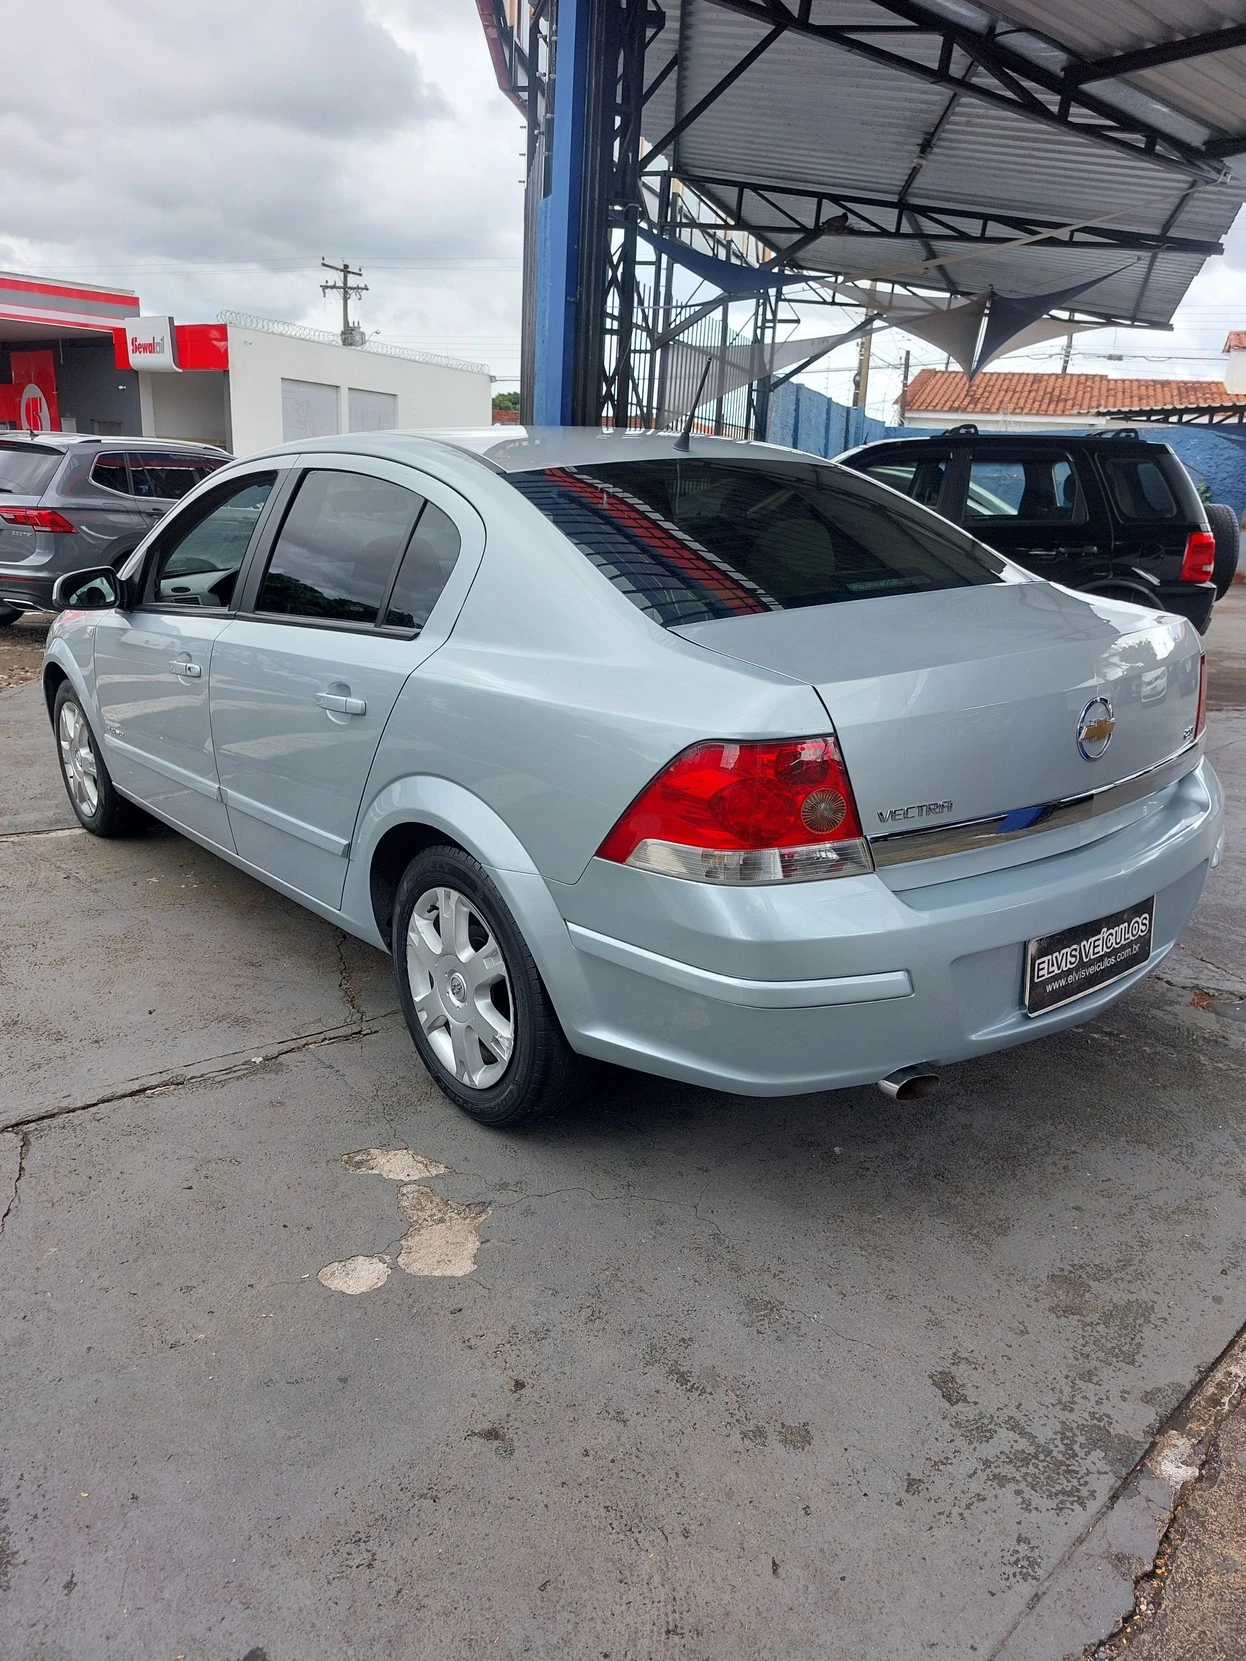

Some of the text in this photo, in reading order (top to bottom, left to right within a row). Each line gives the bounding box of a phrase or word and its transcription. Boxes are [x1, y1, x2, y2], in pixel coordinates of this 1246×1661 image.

[876, 800, 954, 823] VECTRA
[1034, 913, 1150, 983] ELVIS VEÍCULOS
[1045, 943, 1140, 993] www.elvisveiculos.com.br
